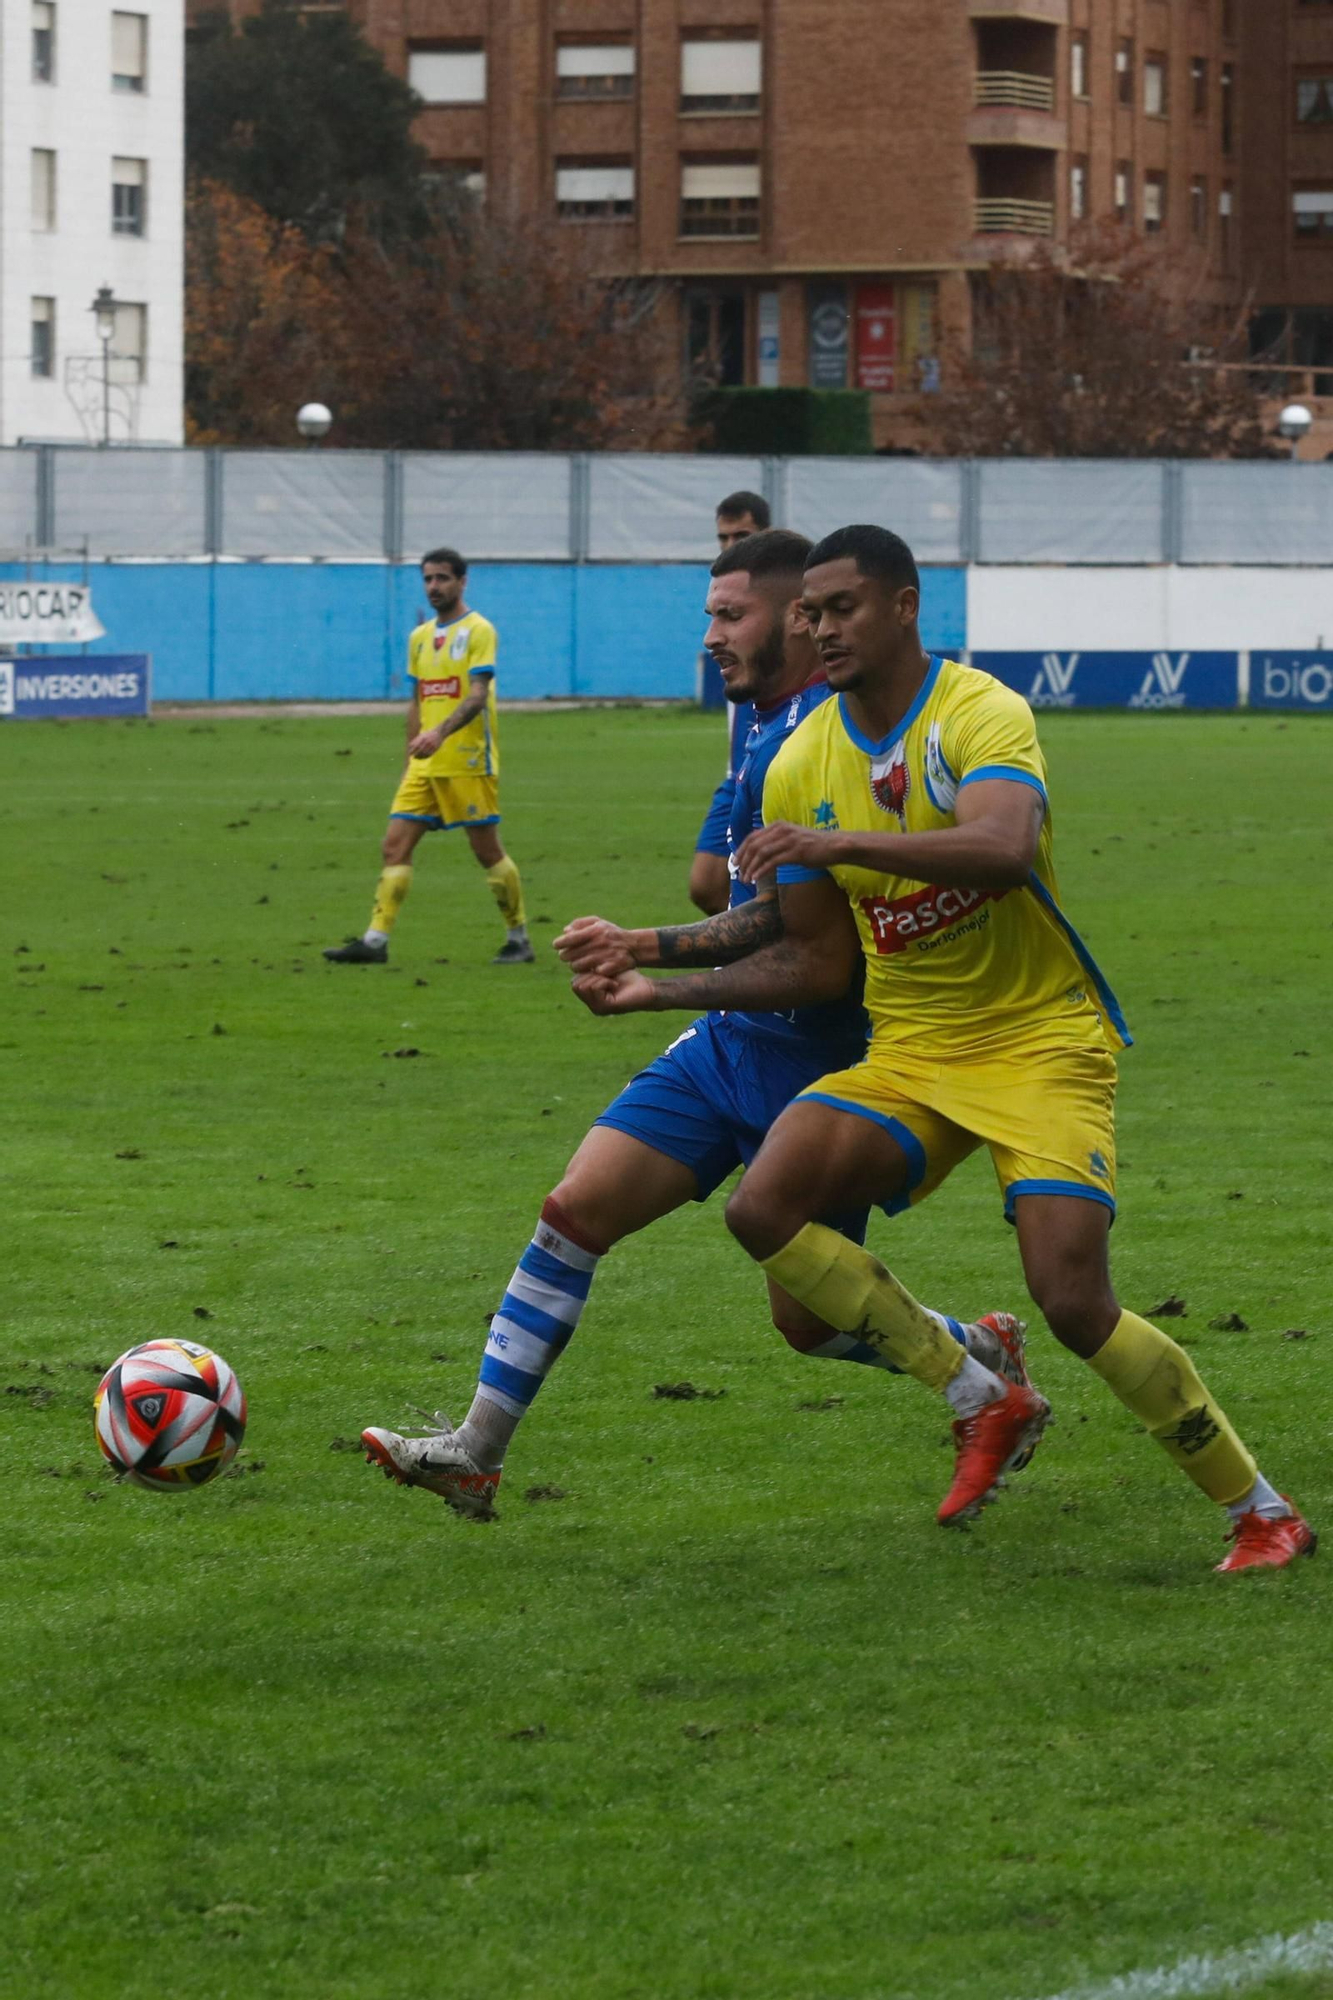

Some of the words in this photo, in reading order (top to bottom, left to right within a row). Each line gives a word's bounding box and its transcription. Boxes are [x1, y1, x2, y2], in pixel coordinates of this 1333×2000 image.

[16, 673, 139, 701] INVERSIONES
[917, 937, 942, 951] Dar
[942, 931, 957, 946] lo
[957, 909, 991, 938] mejor
